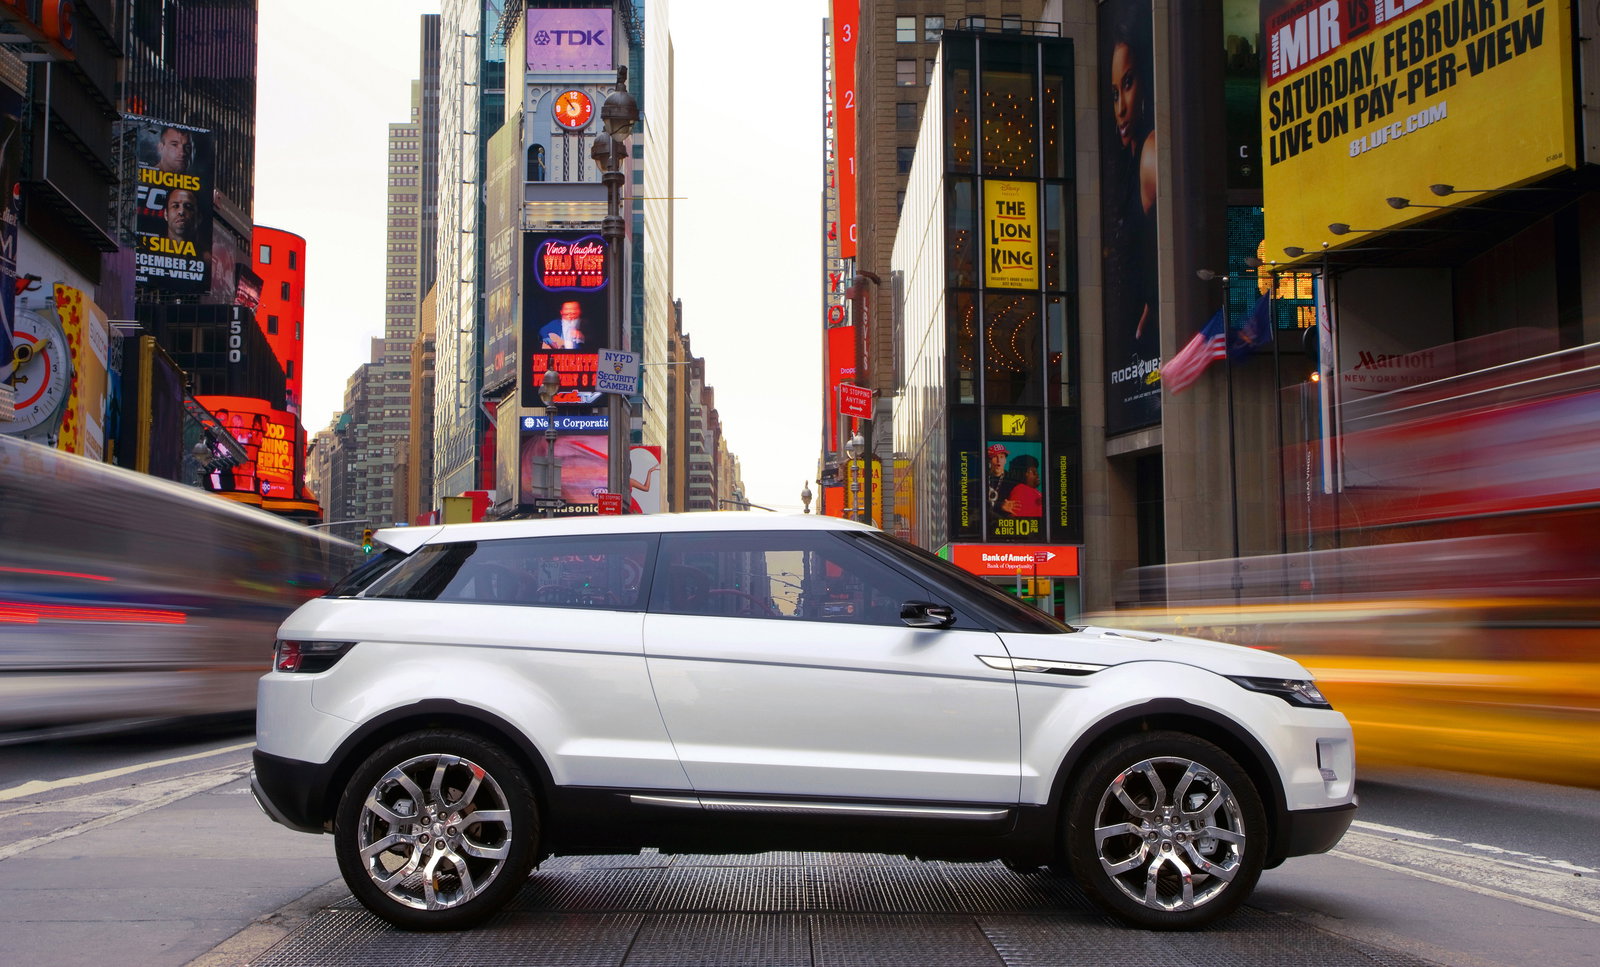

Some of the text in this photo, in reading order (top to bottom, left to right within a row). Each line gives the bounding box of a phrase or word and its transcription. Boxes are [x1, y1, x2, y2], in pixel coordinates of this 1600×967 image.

[550, 30, 605, 46] TDK
[842, 23, 852, 42] 3
[1279, 0, 1341, 76] MIR
[1271, 31, 1281, 79] FRANK
[1269, 41, 1378, 131] SATURDAY,
[1270, 119, 1313, 166] LIVE
[1317, 102, 1349, 144] ON
[1354, 7, 1545, 129] PAY-PER-VIEW
[569, 91, 578, 100] 12
[844, 90, 855, 109] 2
[586, 105, 591, 113] 3
[1349, 100, 1447, 158] 81.UFC.COM
[848, 157, 855, 174] 1
[142, 169, 201, 191] HUGHES
[137, 186, 165, 209] FC
[996, 200, 1026, 216] THE
[990, 219, 1032, 245] LION
[149, 236, 197, 257] SILVA
[489, 226, 515, 262] PLANET
[545, 242, 603, 259] Vince Vaughn's
[189, 260, 205, 272] 29
[495, 251, 512, 272] PERIL
[544, 255, 604, 271] WILD WEST
[990, 247, 1033, 273] KING
[136, 266, 204, 281] -PER-VIEW
[32, 325, 37, 334] 1
[228, 306, 242, 363] 1500
[47, 341, 53, 349] 2
[605, 352, 633, 364] NYPD
[1354, 351, 1435, 370] Marriott
[52, 364, 58, 372] 3
[598, 371, 636, 383] SECURITY
[1344, 374, 1367, 382] NEW
[1370, 375, 1398, 383] YORK
[47, 386, 52, 395] 4
[599, 380, 634, 392] CAMERA
[842, 386, 849, 394] NO
[850, 389, 871, 398] STOPPING
[846, 396, 867, 406] ANYTIME
[266, 422, 284, 440] OOD
[536, 418, 559, 428] Nes
[1002, 414, 1026, 435] MTV
[1060, 455, 1068, 527] ROBANDBIG.MTV.COM
[538, 504, 598, 513] Pasonic
[998, 519, 1014, 527] ROB
[1016, 519, 1030, 535] 10
[982, 553, 1000, 561] Bank
[1001, 553, 1008, 561] of
[1009, 553, 1034, 562] Americ
